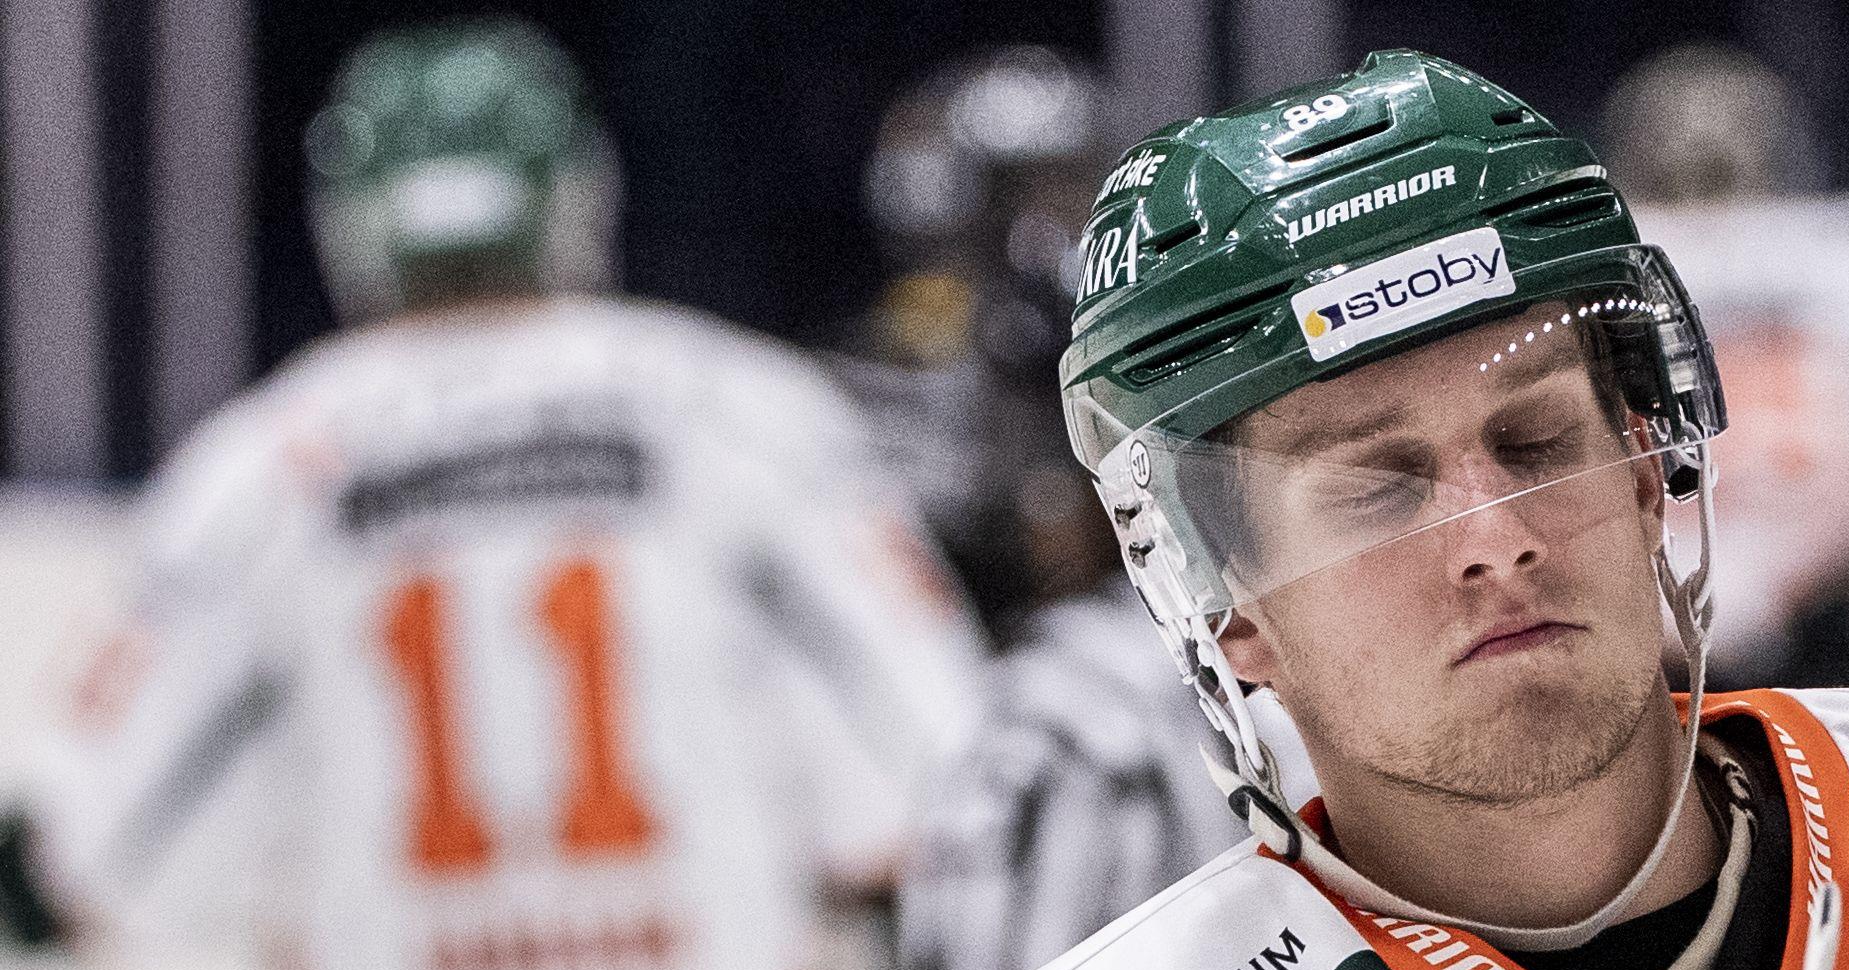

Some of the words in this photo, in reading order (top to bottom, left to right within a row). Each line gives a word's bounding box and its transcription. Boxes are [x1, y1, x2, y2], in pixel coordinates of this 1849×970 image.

[1282, 94, 1350, 132] 89
[1287, 164, 1457, 244] WARRIOR
[1345, 247, 1502, 321] stoby
[375, 556, 658, 870] 11
